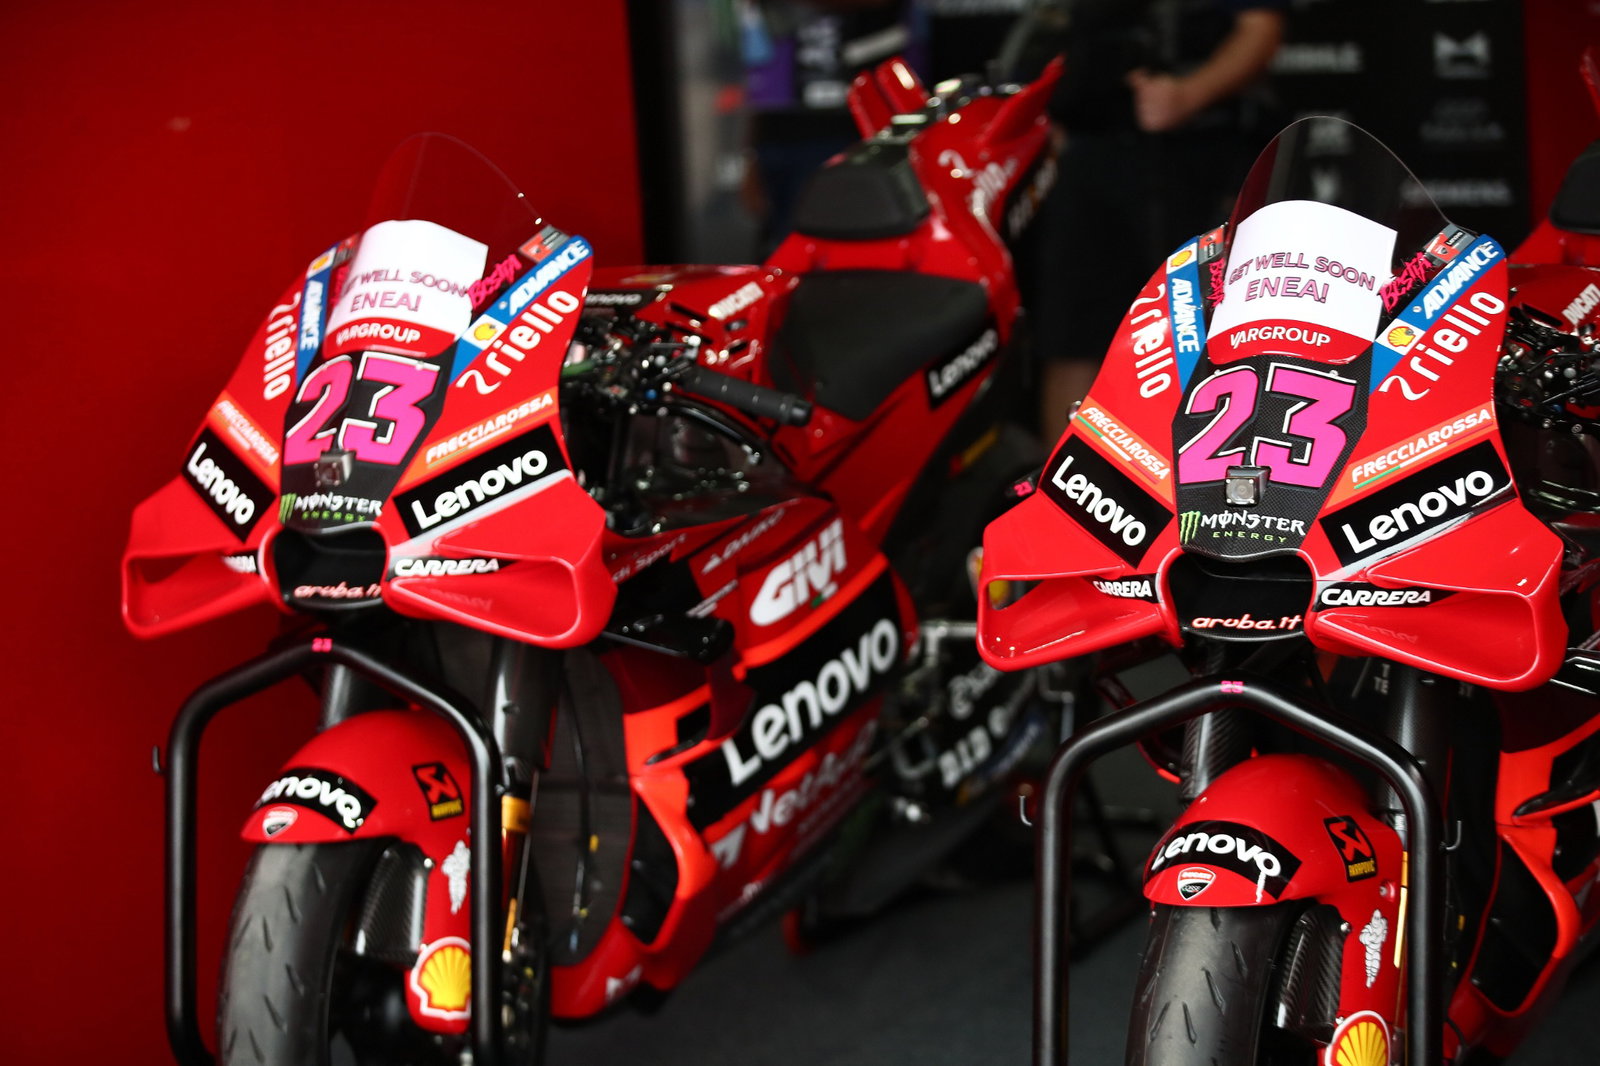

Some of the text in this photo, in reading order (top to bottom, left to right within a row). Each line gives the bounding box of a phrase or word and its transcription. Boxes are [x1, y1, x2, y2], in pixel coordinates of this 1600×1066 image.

[350, 289, 422, 313] ENEA!
[361, 269, 404, 285] WELL
[409, 271, 467, 298] SOON
[1229, 252, 1376, 291] GET WELL SOON
[1245, 276, 1330, 304] ENEA!
[1422, 241, 1499, 320] ADVANCE
[485, 290, 580, 377] riello
[1171, 278, 1200, 353] ADVANCE
[1230, 326, 1331, 349] VARGROUP
[1410, 292, 1505, 382] riello
[263, 314, 298, 401] riello
[283, 351, 441, 467] 23
[425, 393, 553, 463] FRECCIAROSSA
[1082, 407, 1170, 480] FRECCIAROSSA
[1178, 362, 1357, 489] 23
[1351, 409, 1491, 483] FRECCIAROSSA
[187, 441, 256, 525] Lenovo
[411, 450, 548, 530] Lenovo
[1051, 455, 1146, 546] Lenovo
[1341, 470, 1494, 554] Lenovo
[394, 557, 500, 576] CARRERA
[1212, 531, 1287, 543] ENERGY
[1093, 580, 1153, 598] CARRERA
[1191, 613, 1303, 630] aruba.it
[1320, 588, 1431, 606] CARRERA
[721, 618, 899, 787] Lenovo
[257, 776, 361, 821] enovo
[1151, 832, 1282, 877] Lenovo
